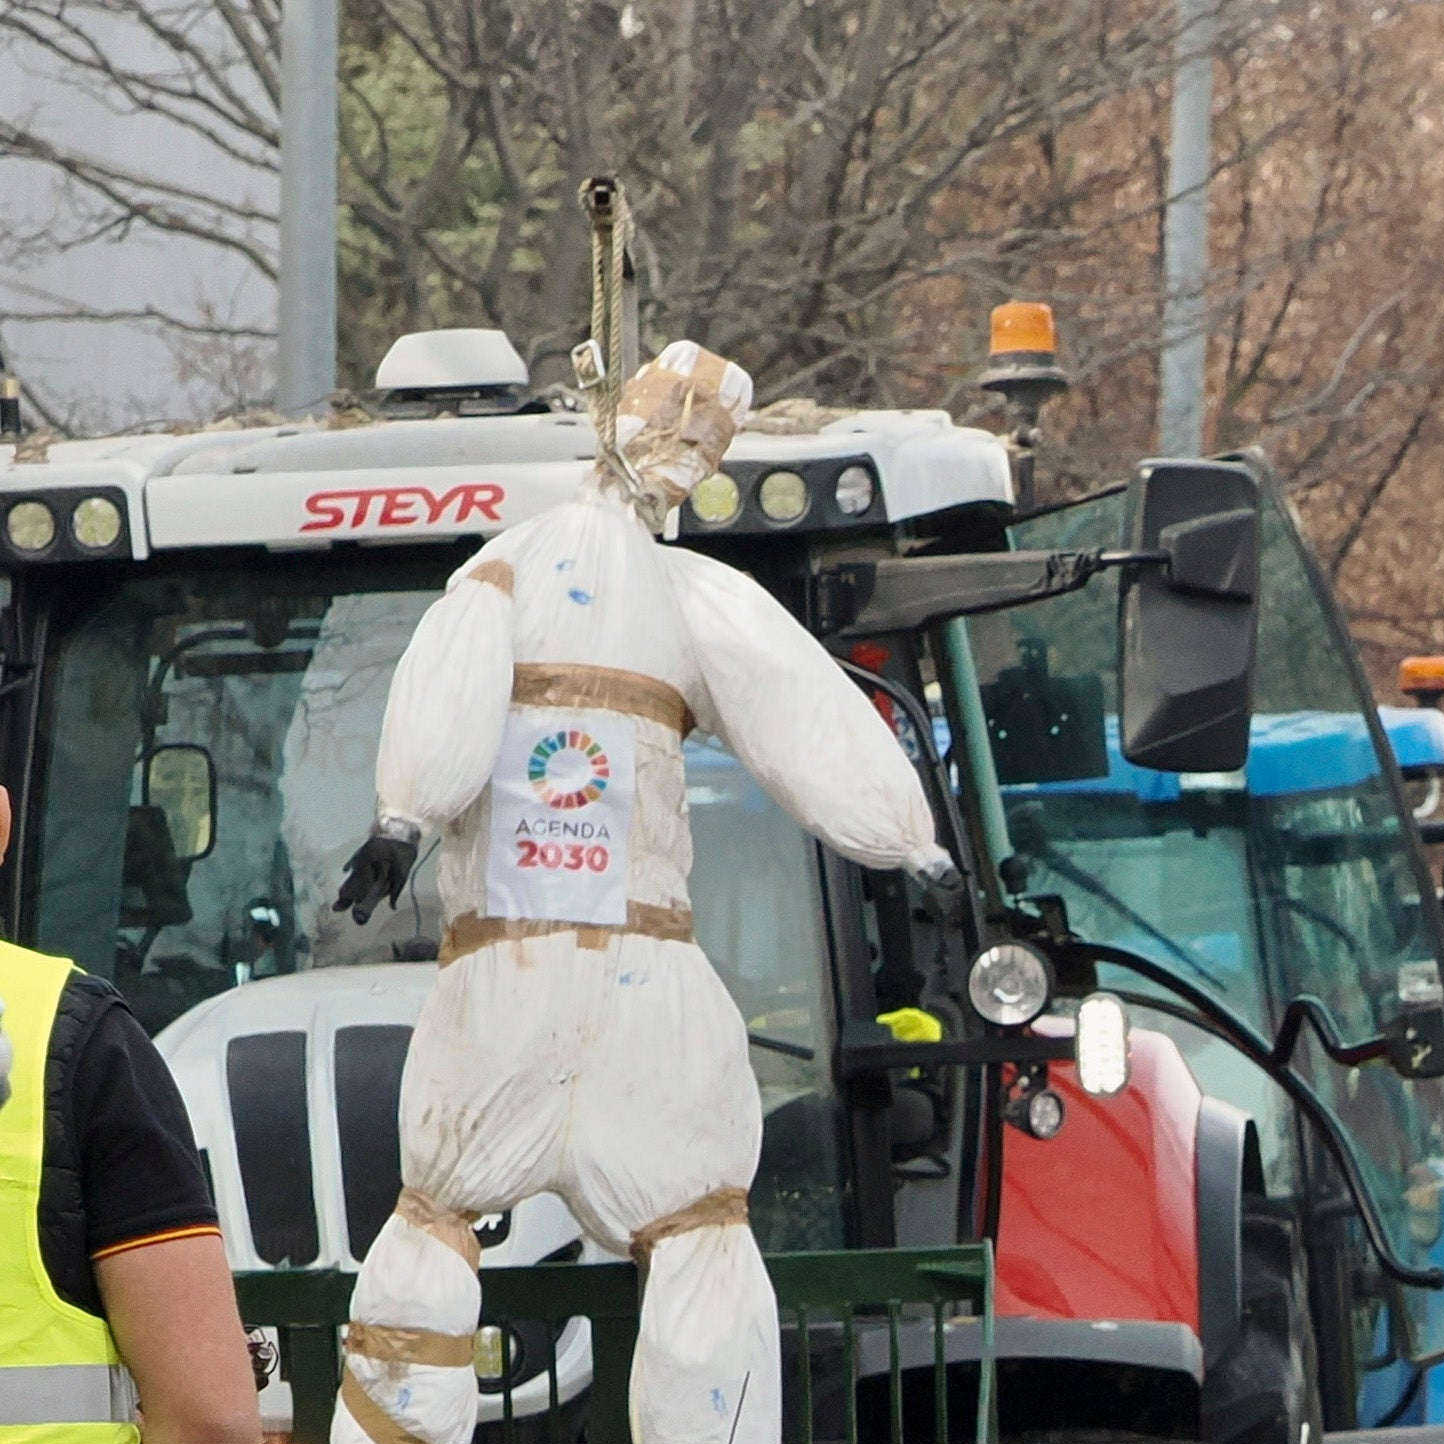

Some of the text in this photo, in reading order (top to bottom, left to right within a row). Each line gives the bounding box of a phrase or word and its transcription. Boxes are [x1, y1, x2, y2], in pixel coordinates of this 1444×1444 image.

[301, 483, 505, 533] STEYR
[515, 818, 610, 841] AGENDA
[516, 839, 609, 873] 2030
